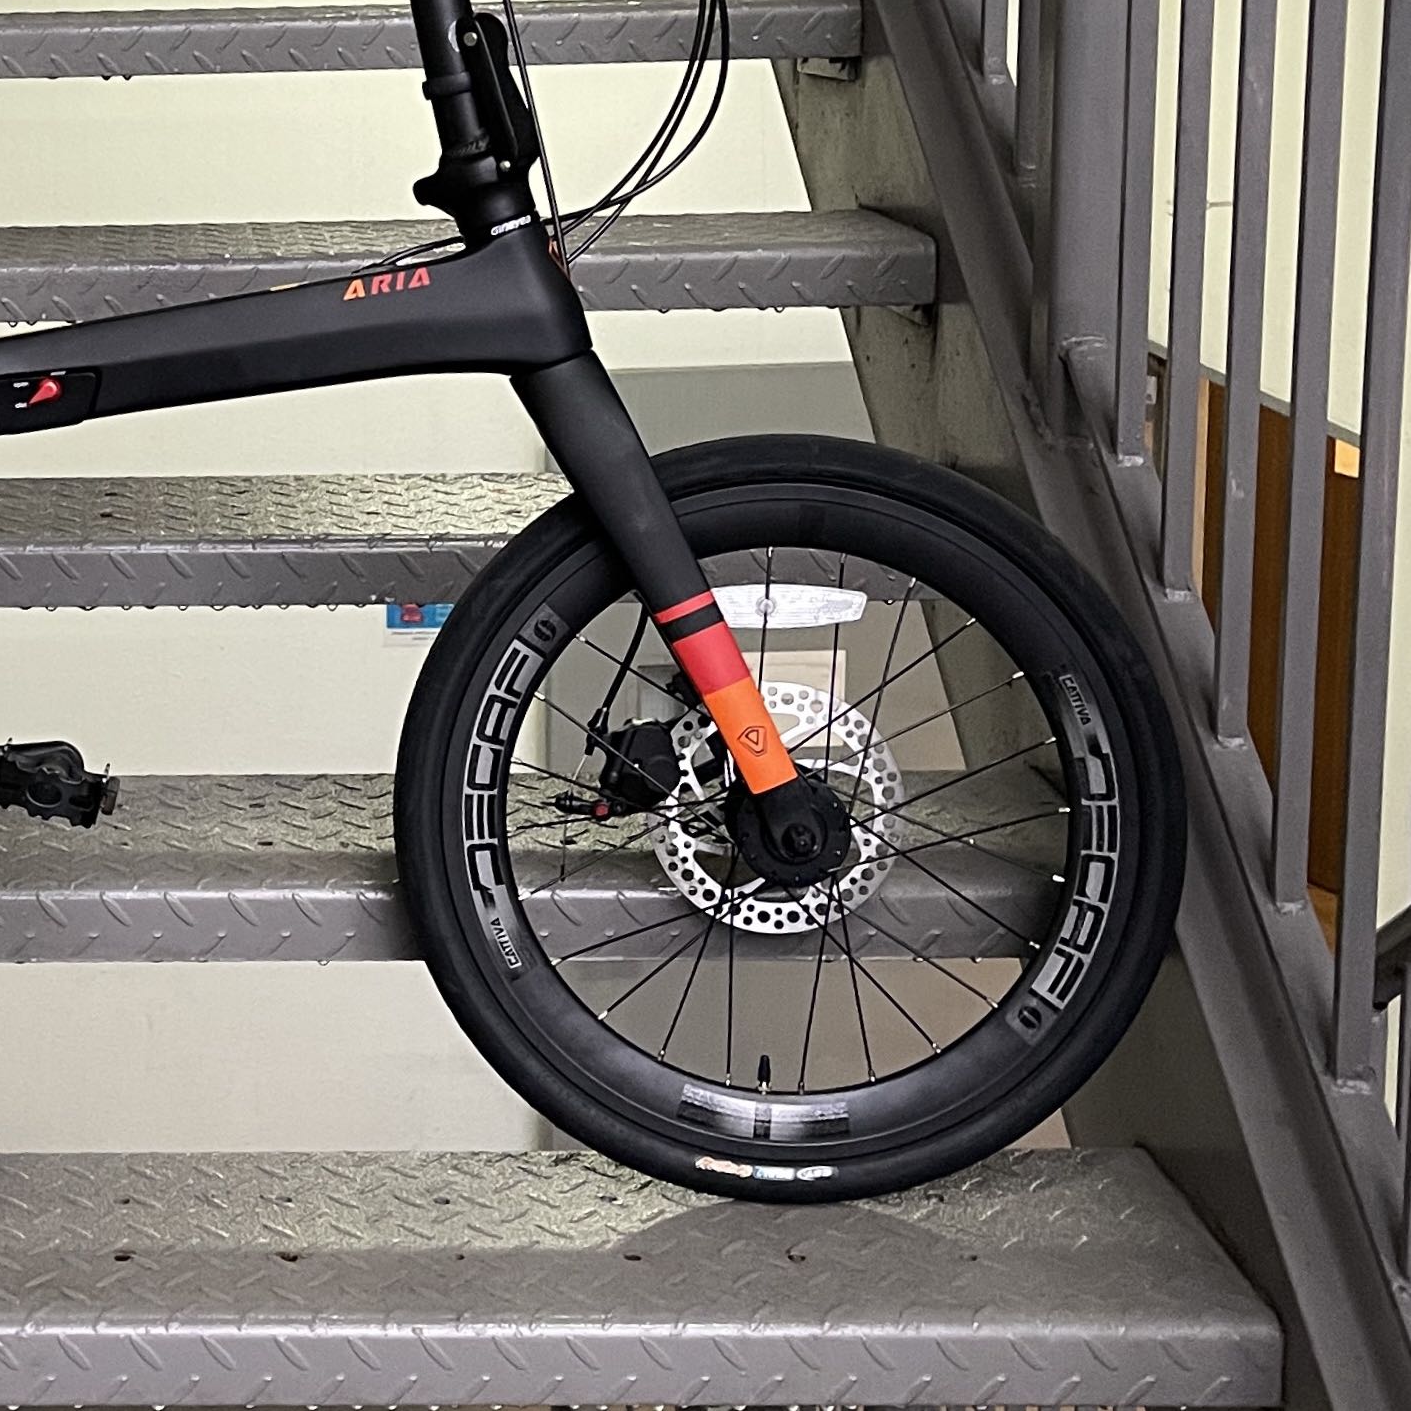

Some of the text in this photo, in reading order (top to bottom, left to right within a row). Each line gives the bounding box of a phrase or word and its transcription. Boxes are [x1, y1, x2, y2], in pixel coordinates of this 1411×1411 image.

[343, 267, 430, 301] ARIA
[1061, 675, 1092, 726] CATTIVA
[463, 643, 530, 892] DECAF
[1046, 751, 1118, 1003] DECAF
[490, 917, 520, 967] CATTIVA
